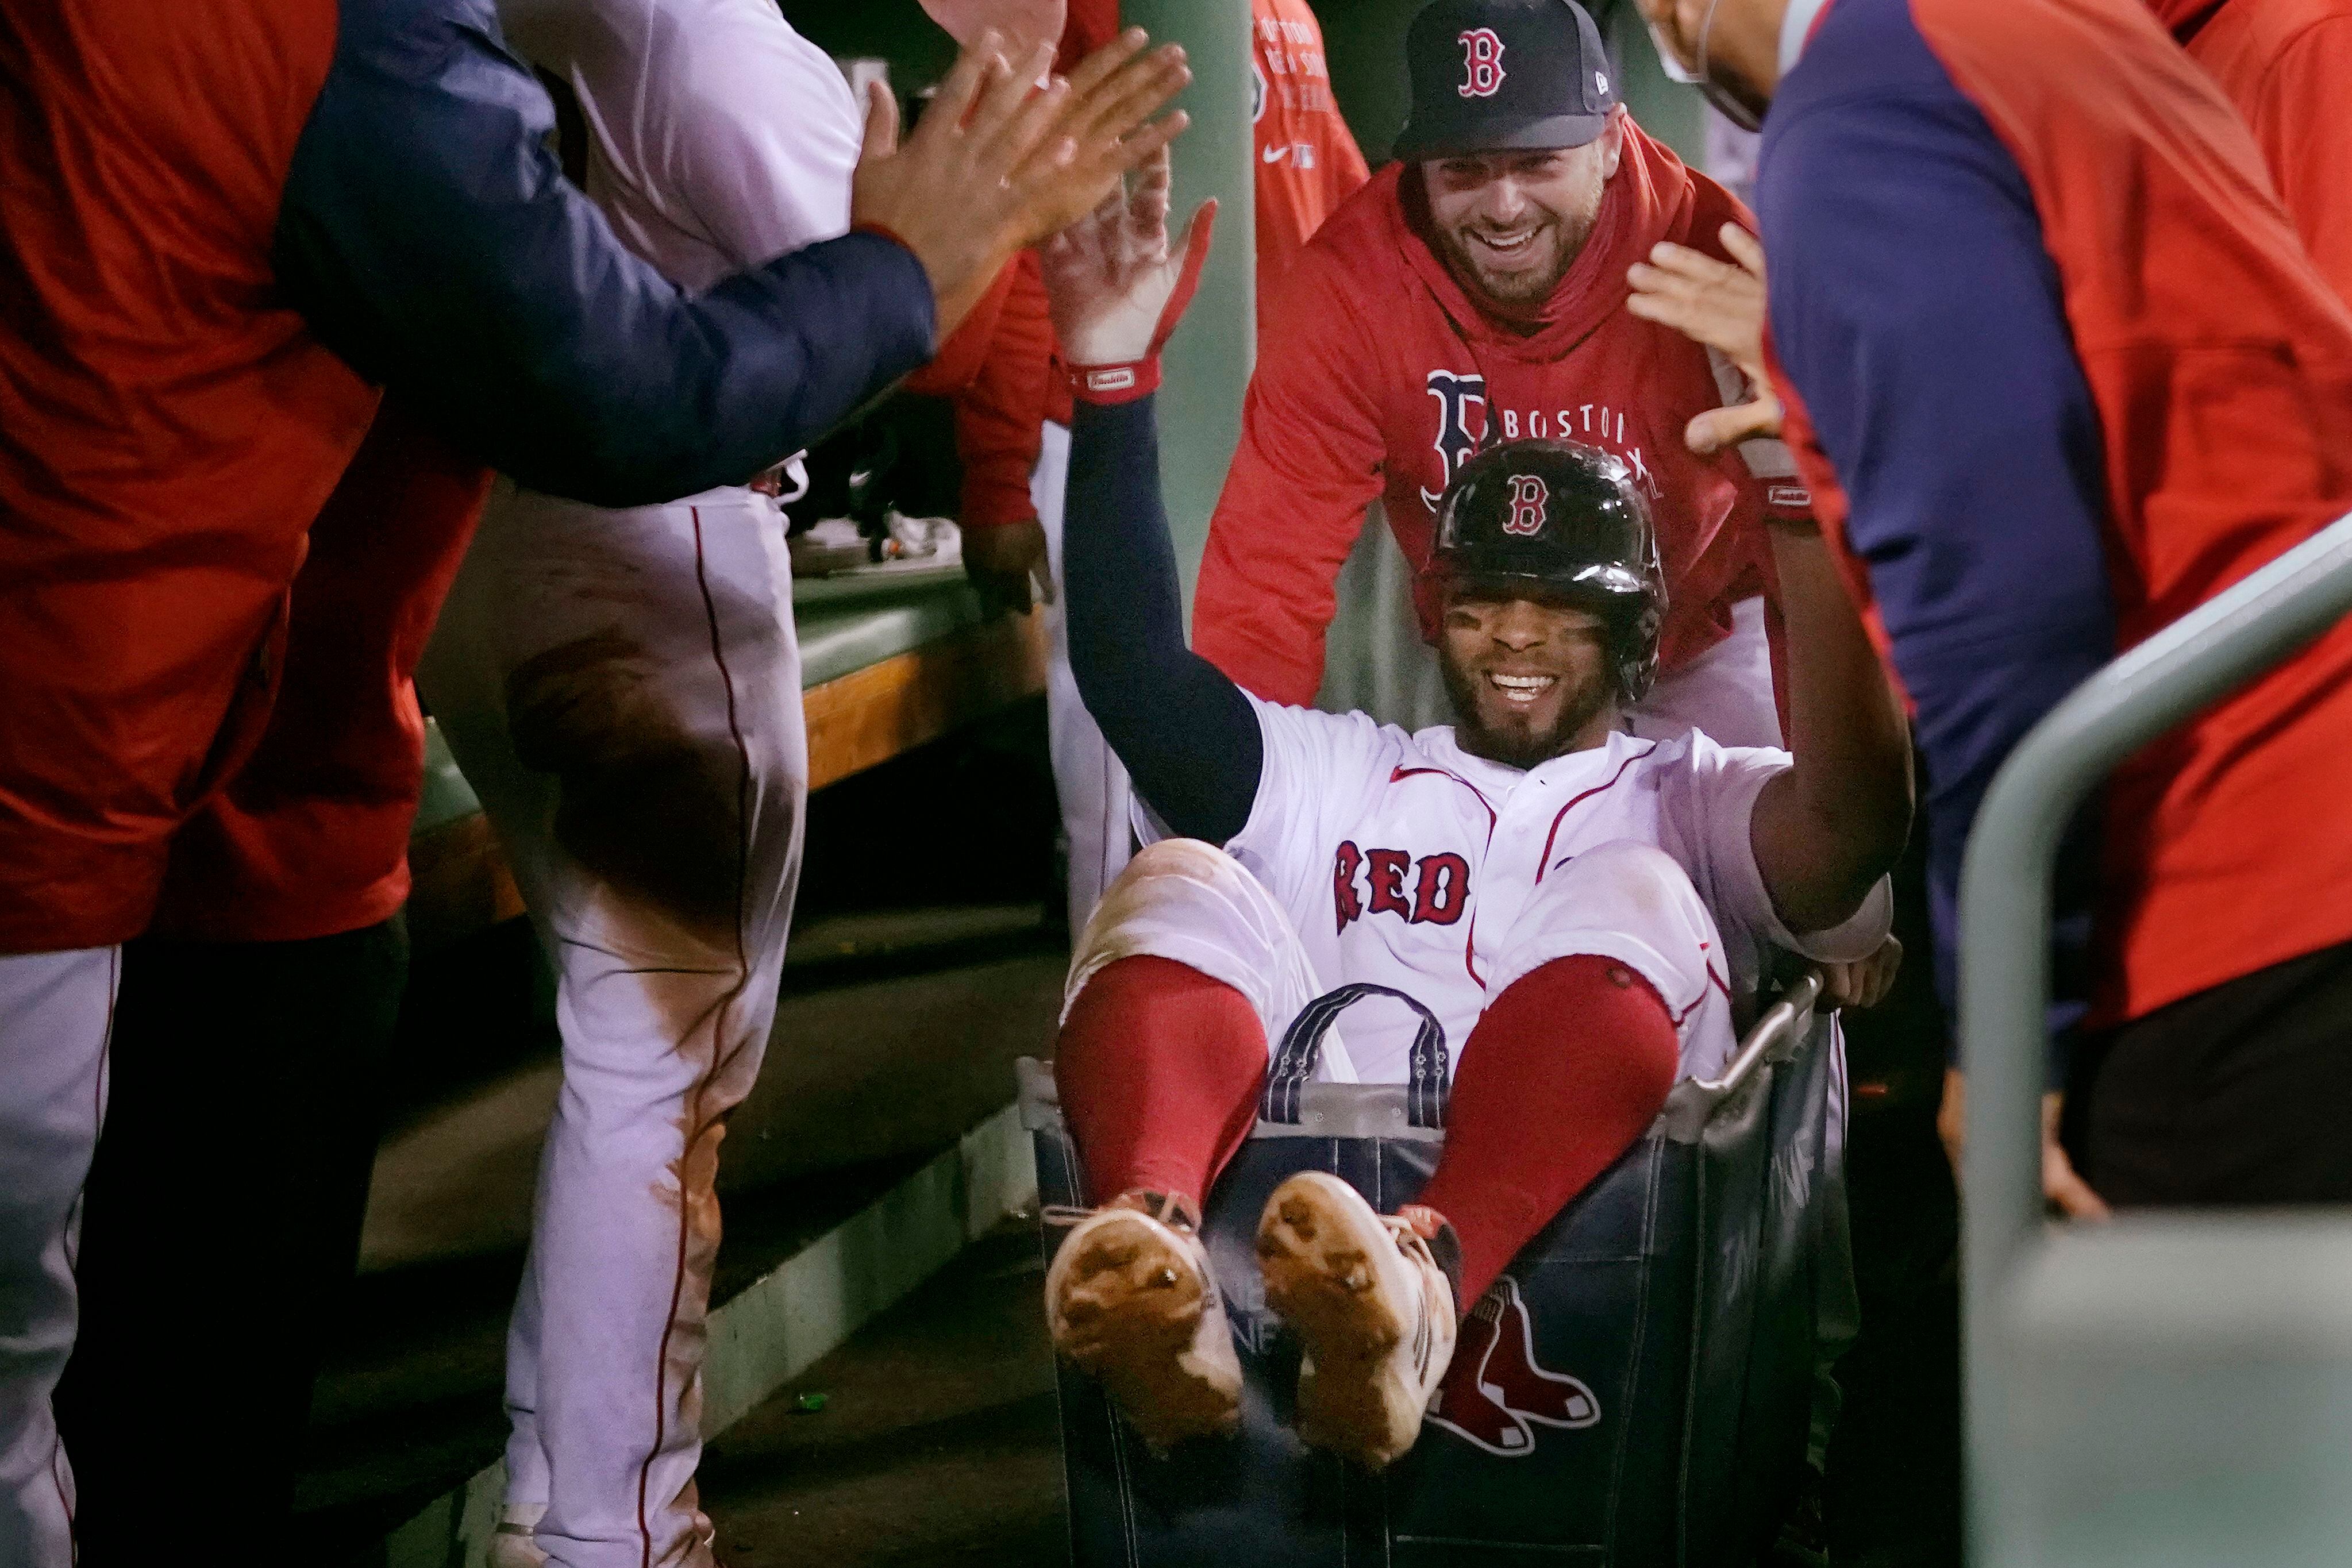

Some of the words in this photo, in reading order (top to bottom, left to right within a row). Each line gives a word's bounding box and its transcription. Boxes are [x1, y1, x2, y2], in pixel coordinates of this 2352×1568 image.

[1457, 27, 1506, 98] B
[1503, 474, 1549, 536] B
[1333, 840, 1471, 937] RED
